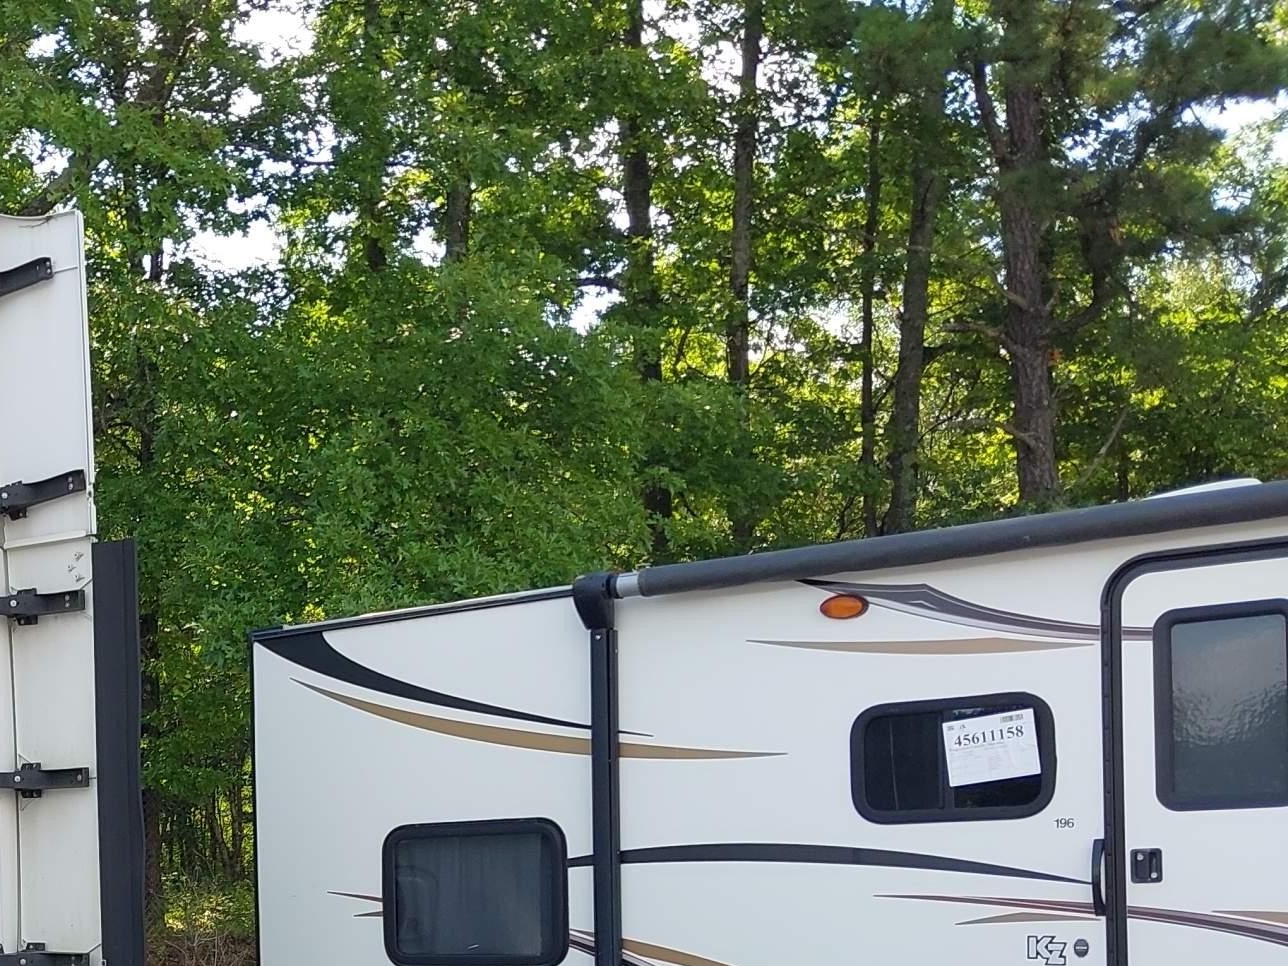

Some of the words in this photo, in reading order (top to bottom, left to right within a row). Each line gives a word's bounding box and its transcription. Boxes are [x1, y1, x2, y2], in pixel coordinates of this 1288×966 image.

[954, 725, 1024, 747] 45611158
[1054, 818, 1075, 829] 196
[1027, 935, 1067, 966] KZ
